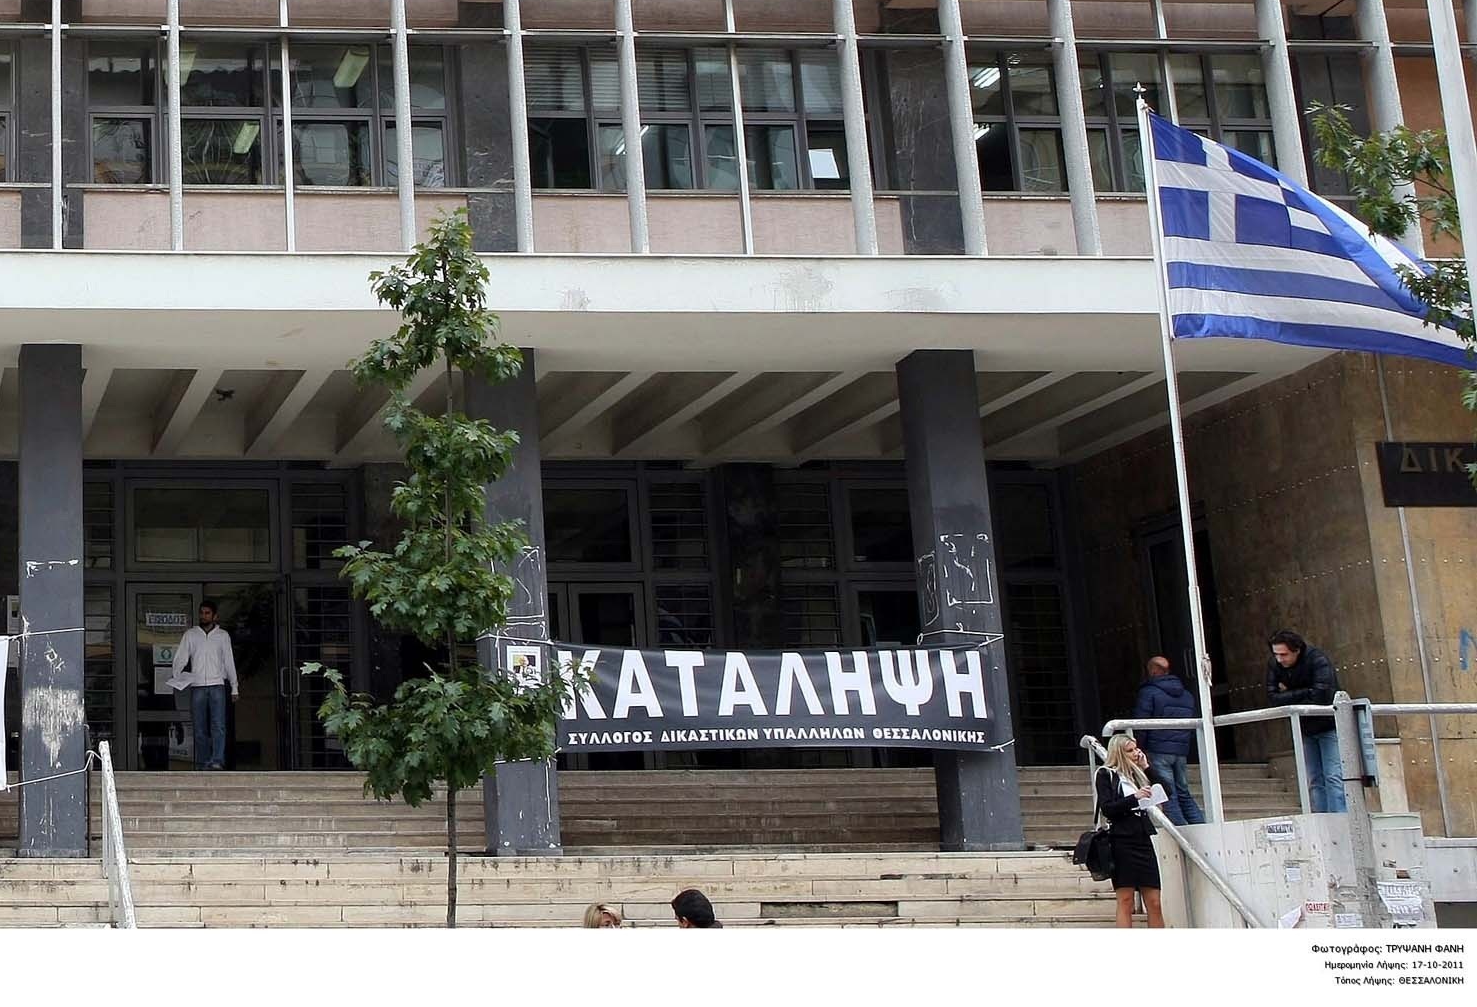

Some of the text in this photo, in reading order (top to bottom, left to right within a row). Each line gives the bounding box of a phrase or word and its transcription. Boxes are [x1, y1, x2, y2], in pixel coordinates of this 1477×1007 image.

[557, 648, 988, 720] ΚΑΤΑΛΗΨΗ
[568, 727, 985, 744] ΣΥΛΛΟΓΟΣ ΔΙΚΑΣΤΙΚΩΝ ΥΠΑΛΛΗΛΩΝ ΘΕΣΣΑΛΟΝΙΚΗΣ
